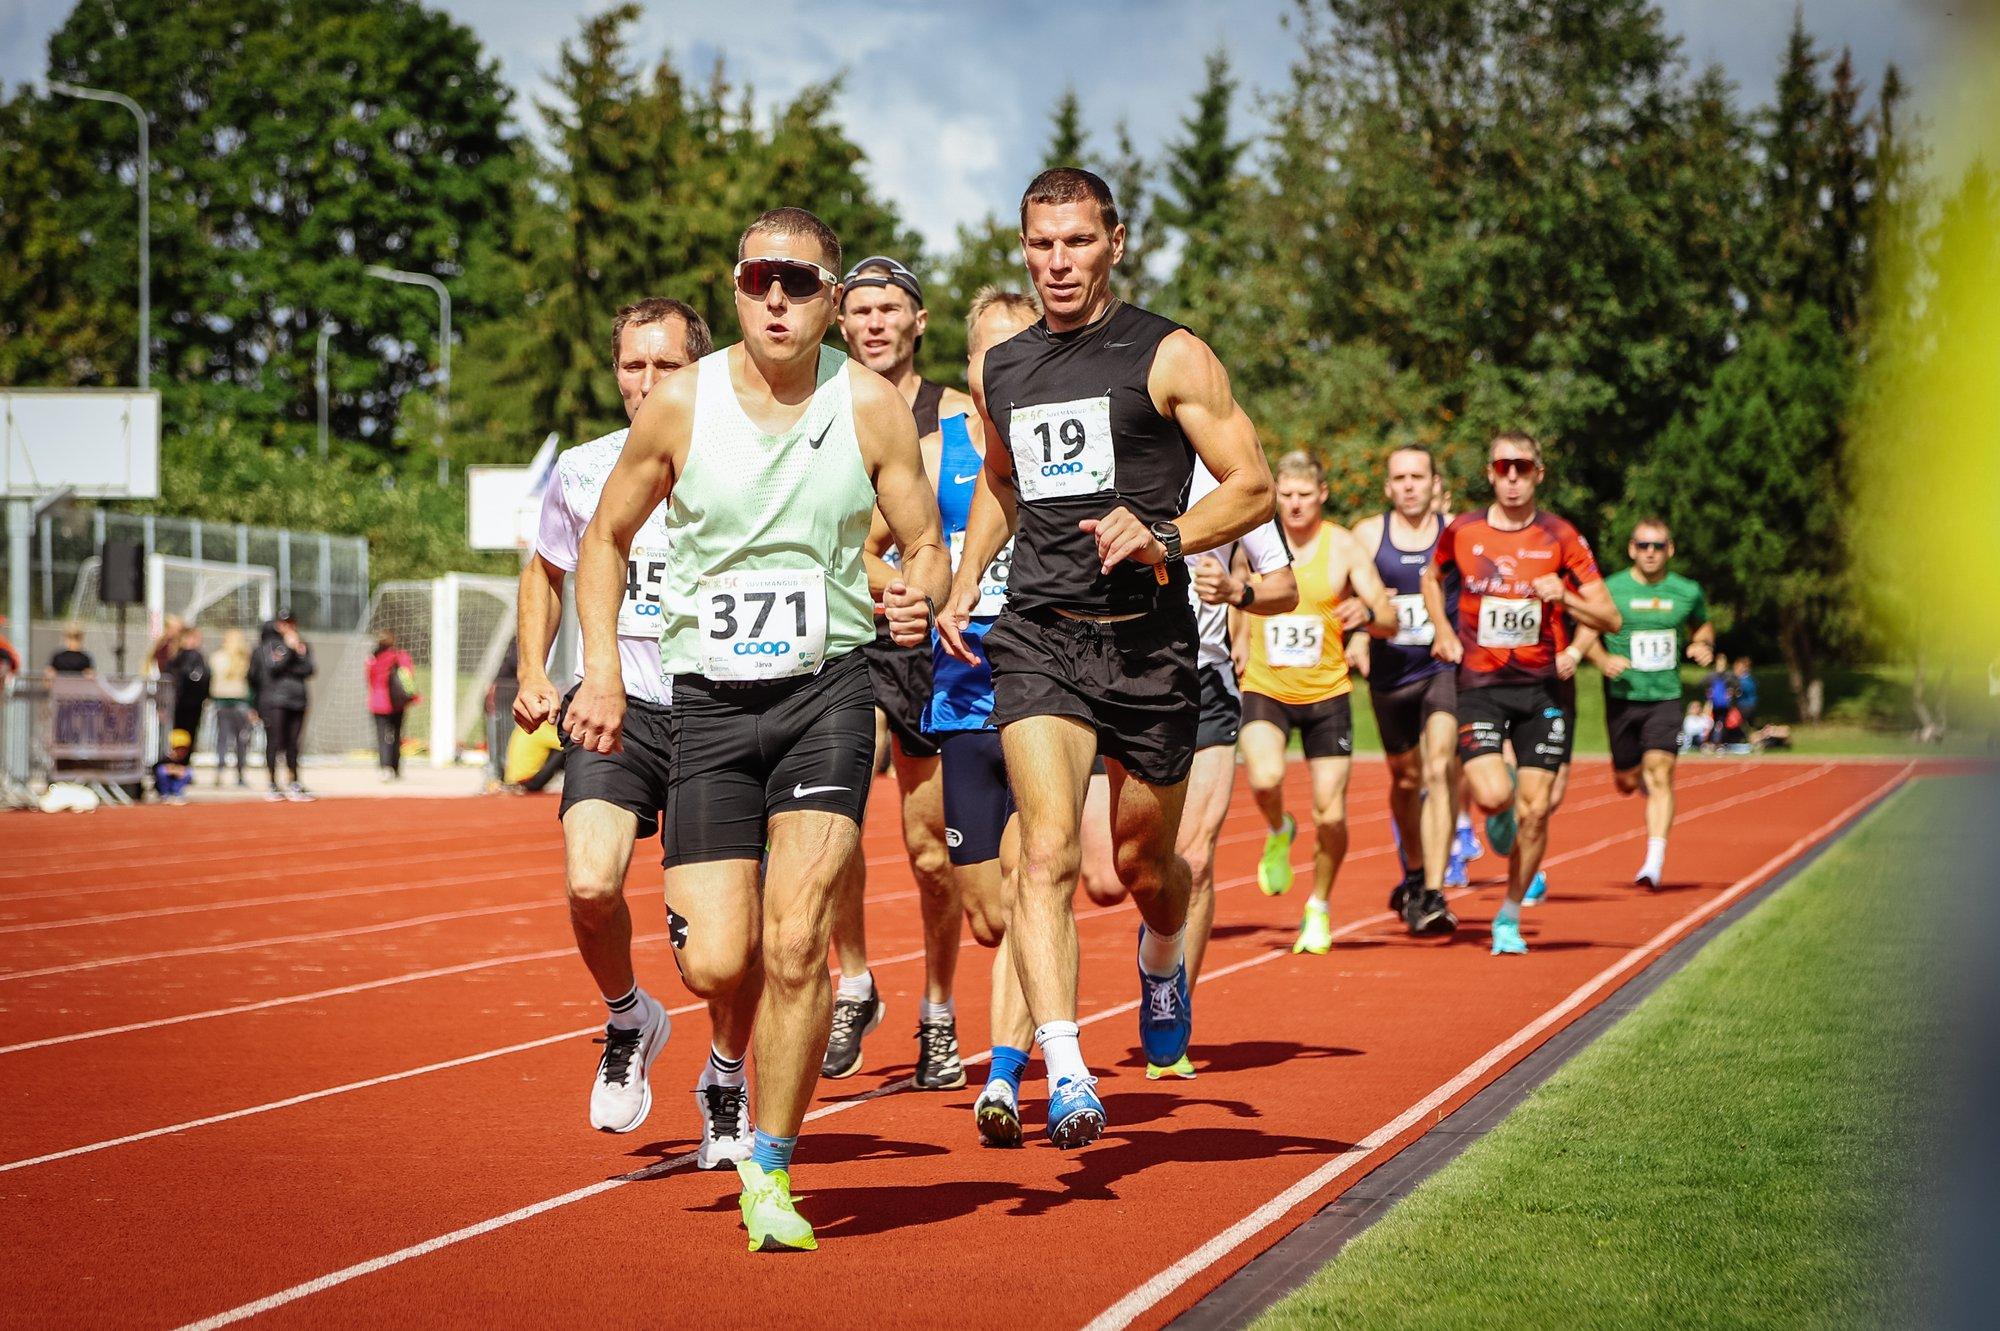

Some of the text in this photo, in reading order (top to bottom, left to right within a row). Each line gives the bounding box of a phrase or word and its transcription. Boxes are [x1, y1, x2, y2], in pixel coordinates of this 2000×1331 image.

[1033, 418, 1086, 463] 19
[1041, 461, 1083, 477] coop
[710, 591, 807, 640] 371
[1488, 610, 1535, 631] 186
[1272, 626, 1316, 648] 135
[733, 641, 791, 657] coop
[1639, 641, 1672, 657] 113
